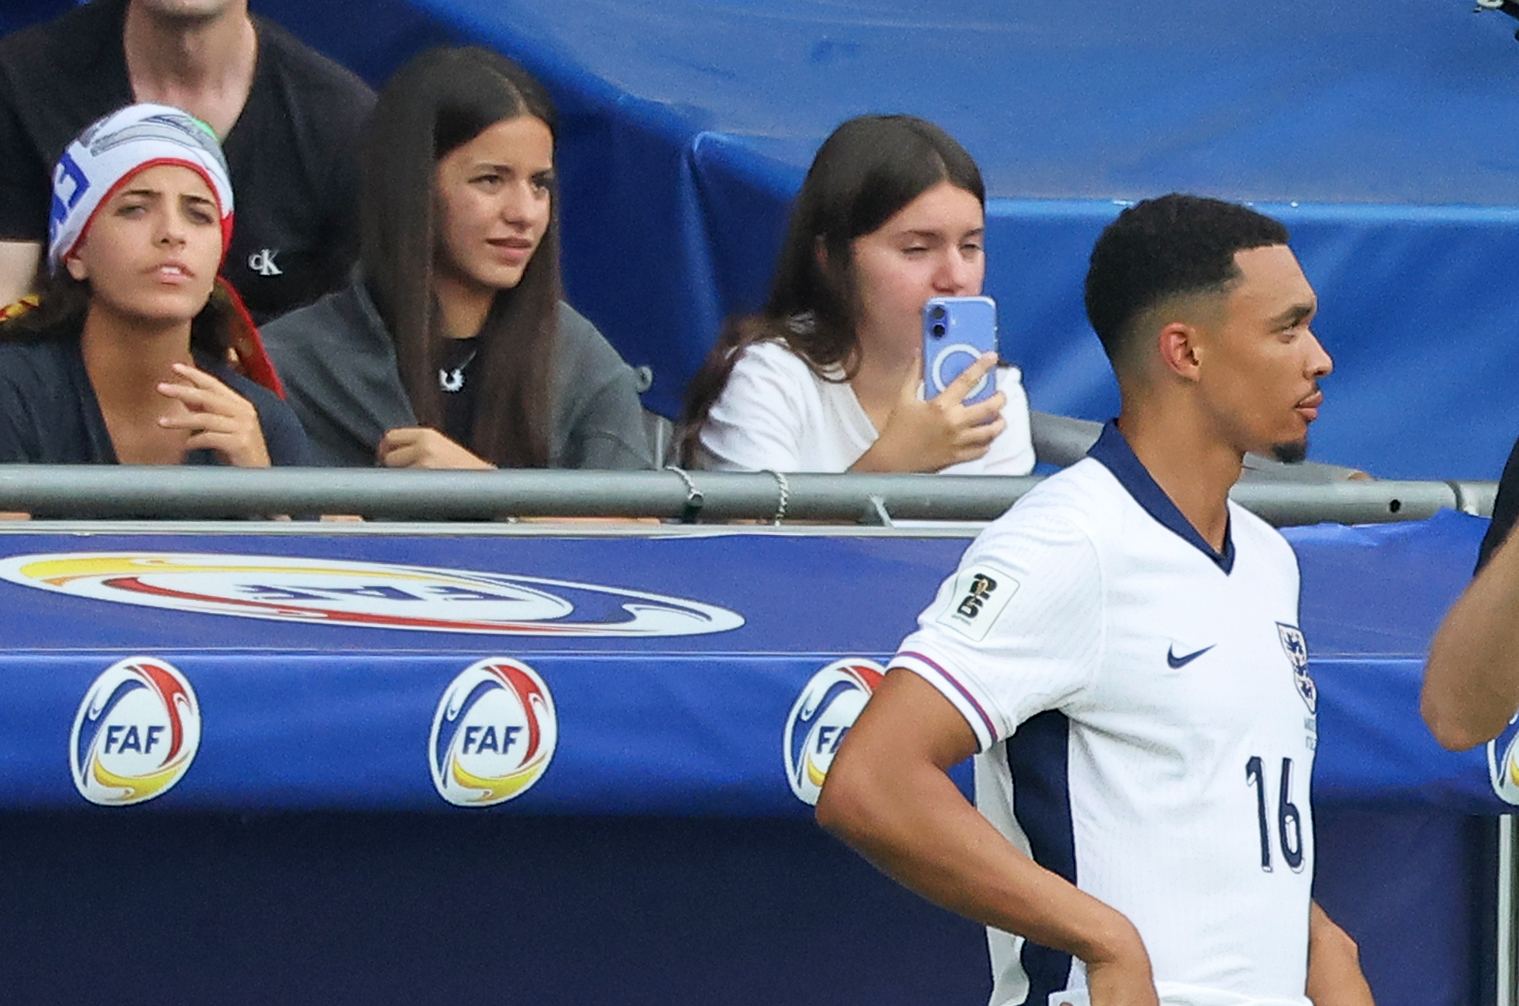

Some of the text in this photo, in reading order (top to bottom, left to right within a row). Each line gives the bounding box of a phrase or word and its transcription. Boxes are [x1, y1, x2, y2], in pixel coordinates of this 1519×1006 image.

[104, 725, 166, 755] FAF
[462, 725, 523, 755] FAF
[1245, 756, 1305, 874] 16
